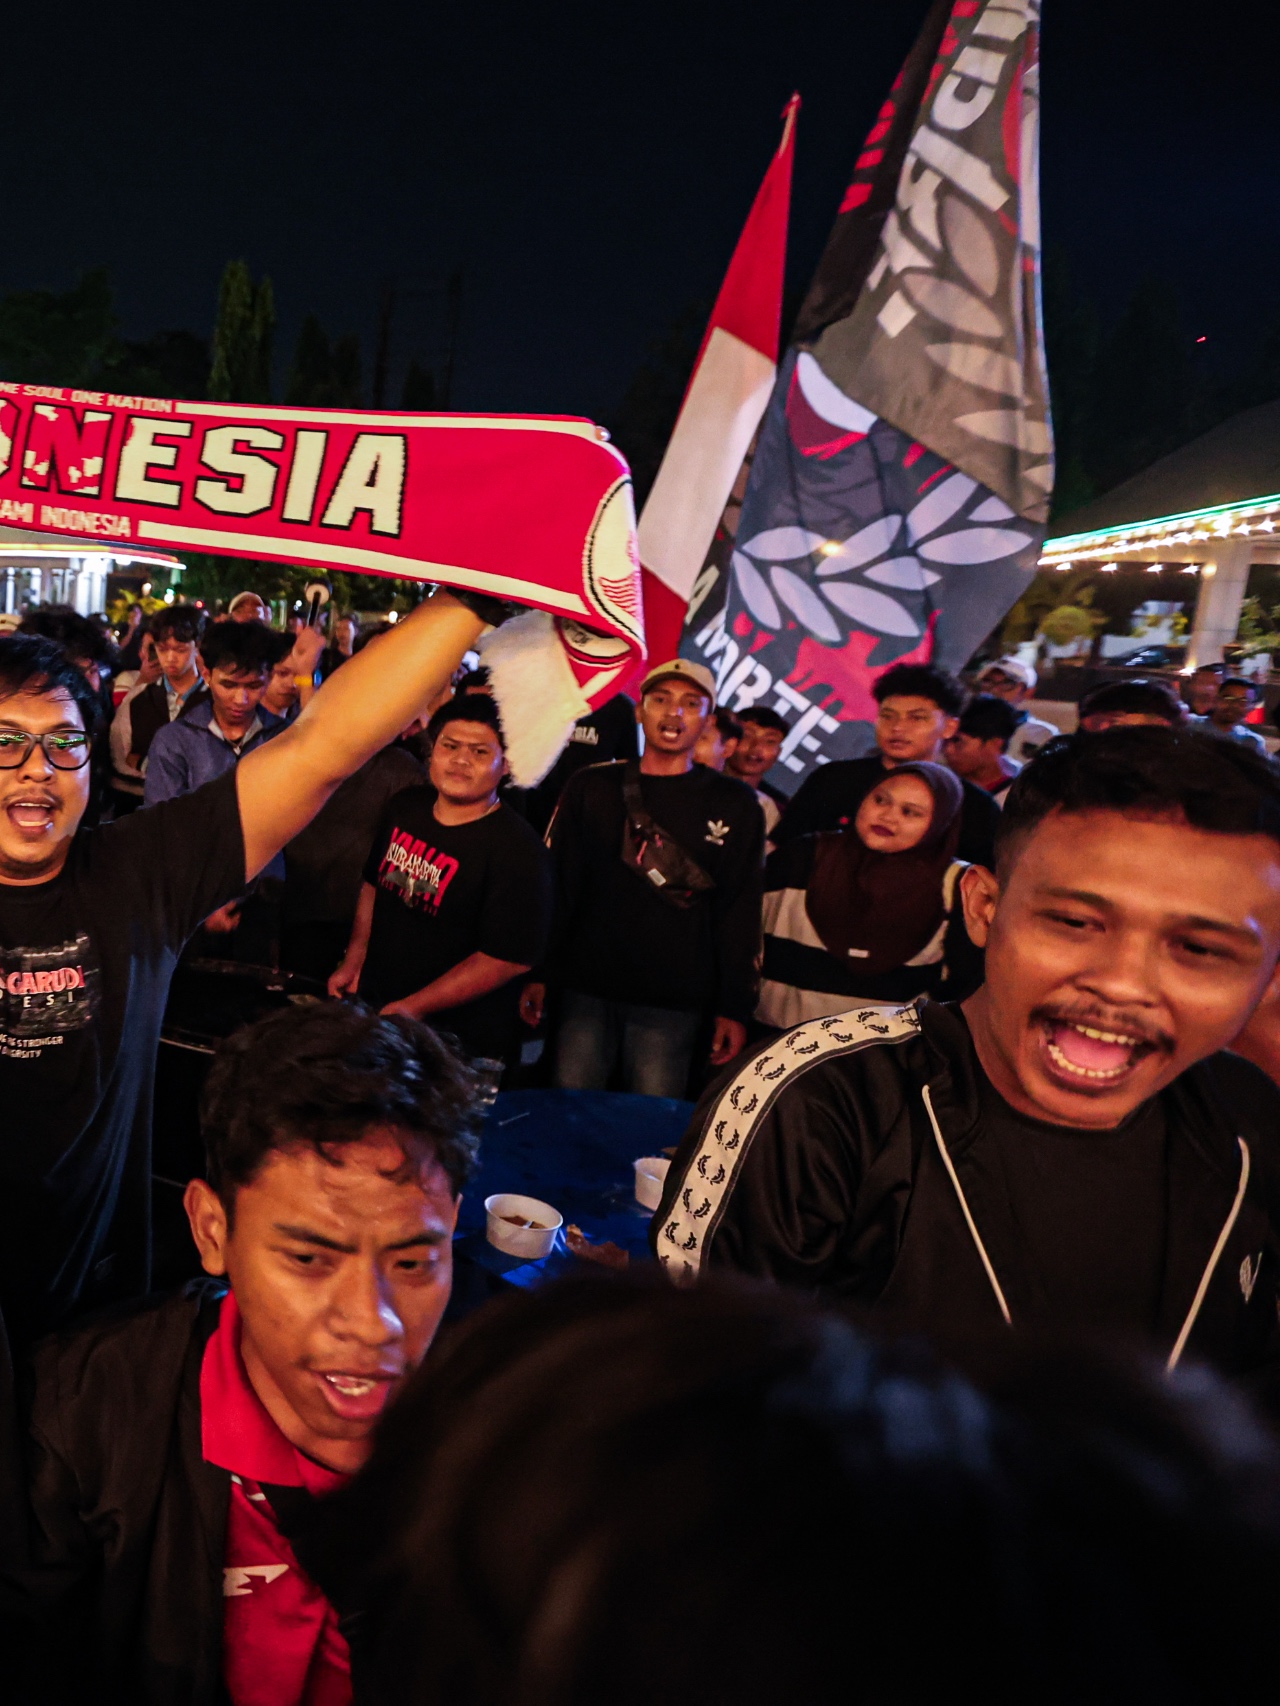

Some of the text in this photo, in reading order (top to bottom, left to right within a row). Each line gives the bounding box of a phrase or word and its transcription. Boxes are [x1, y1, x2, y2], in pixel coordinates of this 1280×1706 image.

[23, 384, 68, 401] SOUL
[71, 390, 104, 405] ONE
[107, 394, 172, 413] NATION
[40, 505, 131, 537] INDONESIA
[6, 965, 86, 995] GARUD
